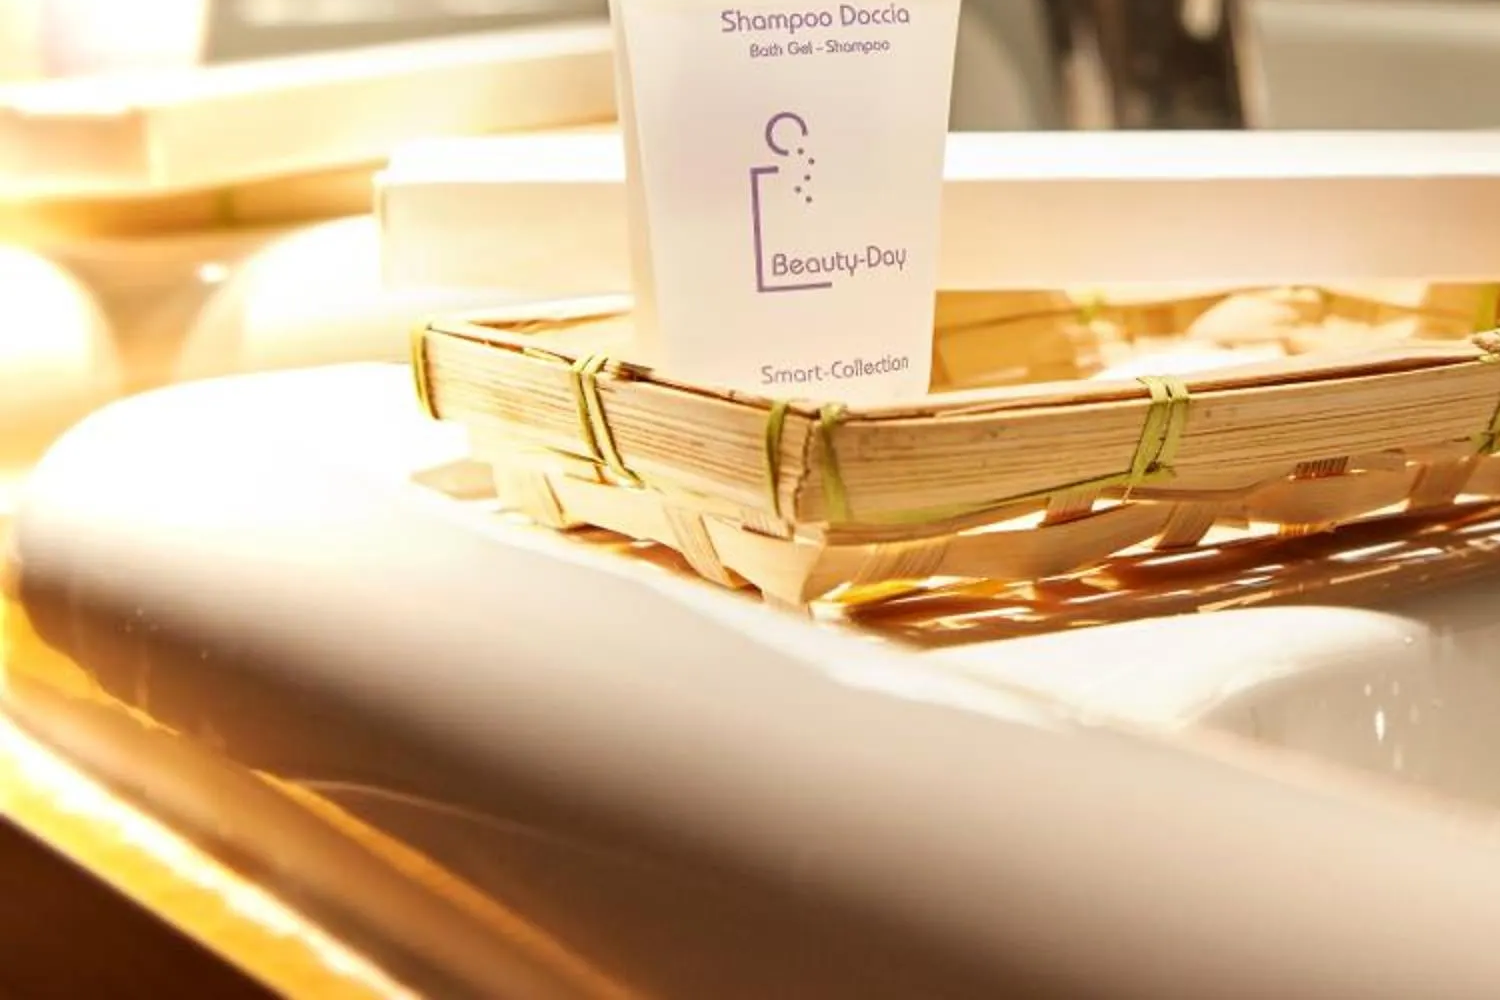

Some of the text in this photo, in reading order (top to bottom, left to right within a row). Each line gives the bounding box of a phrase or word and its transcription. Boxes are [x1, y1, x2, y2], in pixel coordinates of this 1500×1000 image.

[720, 3, 911, 35] Shampoo Doccia
[749, 42, 783, 58] Bath
[787, 40, 813, 55] Gel
[772, 245, 907, 277] Beauty-Day
[761, 354, 909, 384] Smart-Collection
